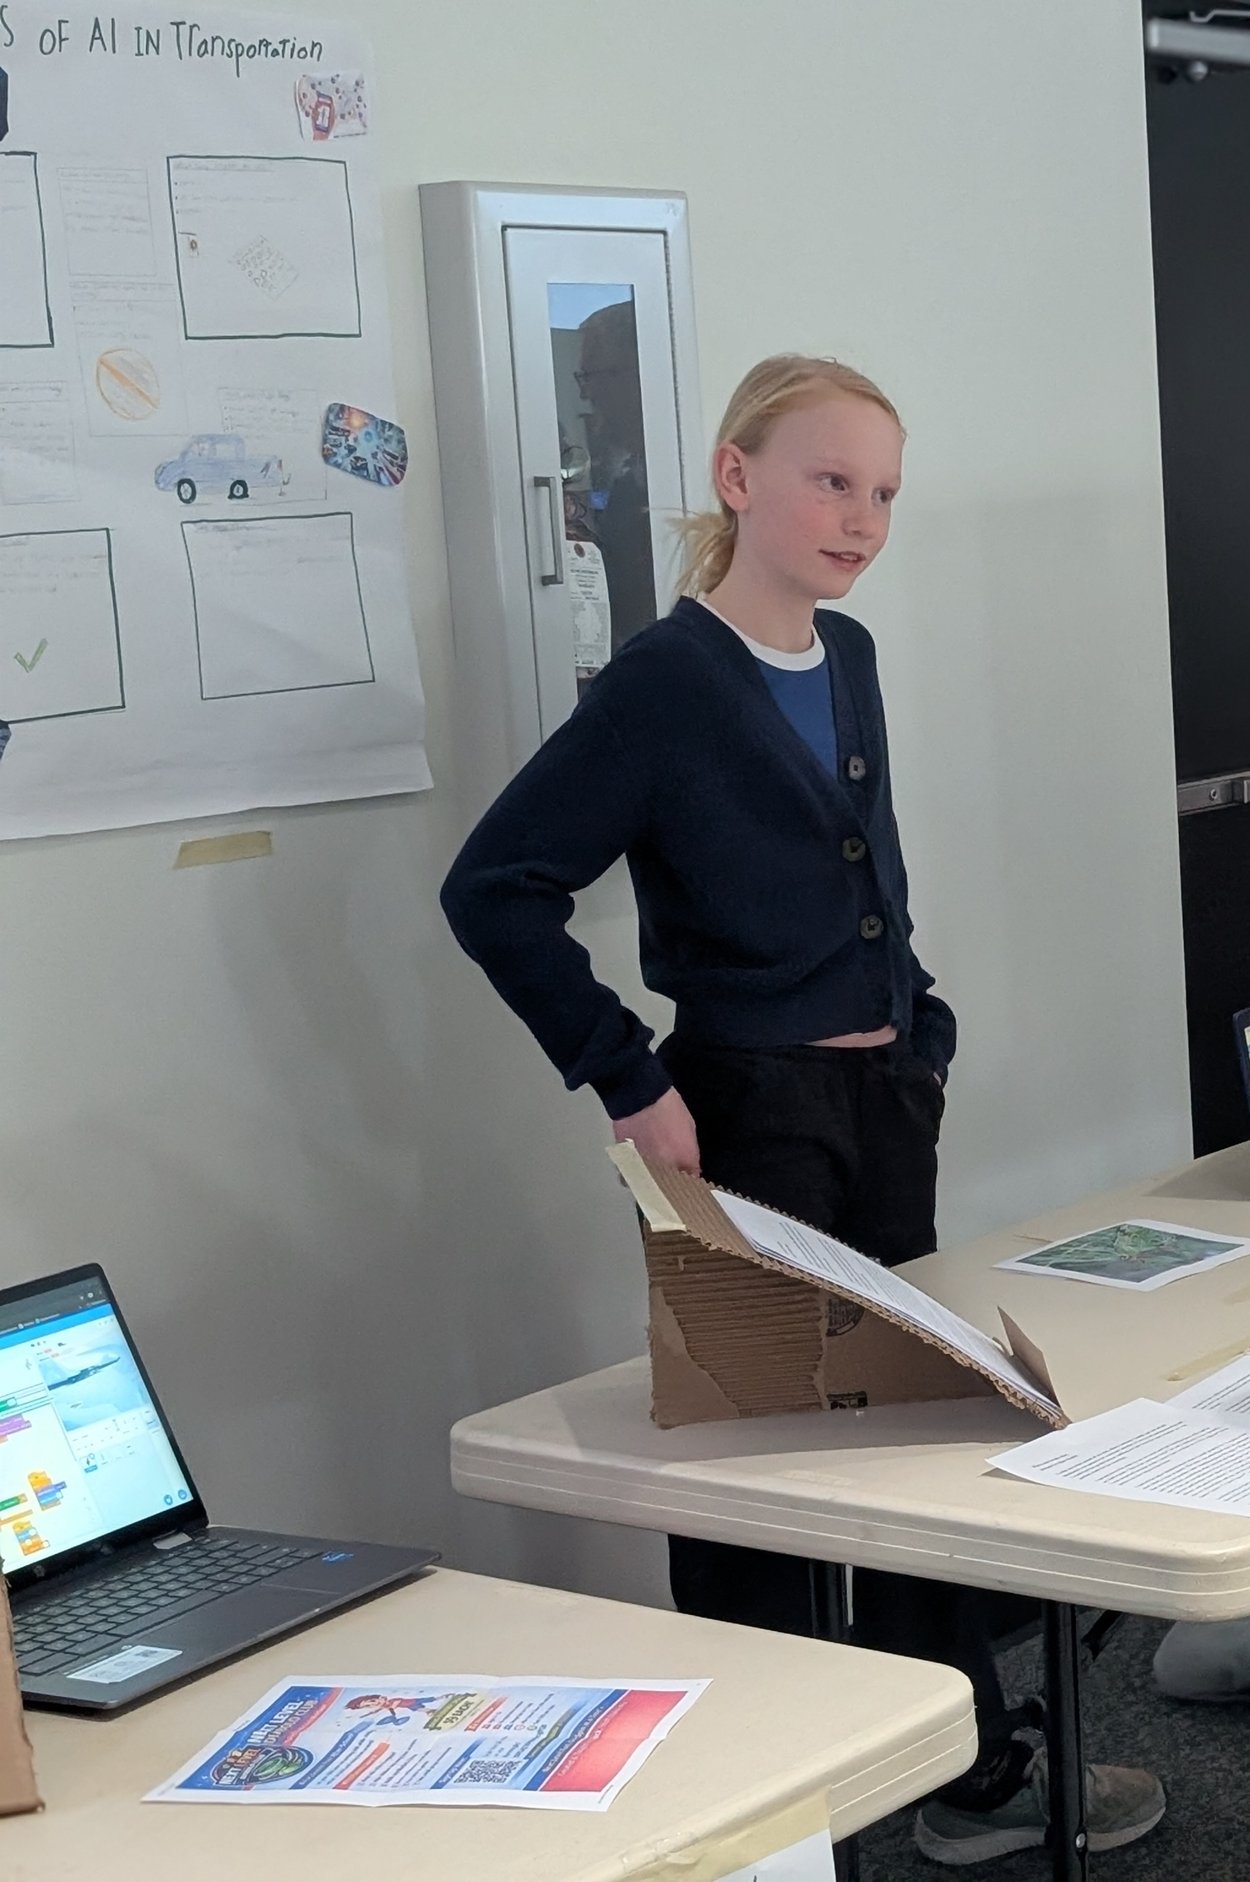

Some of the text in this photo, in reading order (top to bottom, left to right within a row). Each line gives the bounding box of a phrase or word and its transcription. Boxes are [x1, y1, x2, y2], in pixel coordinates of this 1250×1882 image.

[39, 20, 69, 55] OF
[88, 17, 116, 54] AI
[134, 26, 161, 57] IN
[170, 21, 323, 77] Transportation
